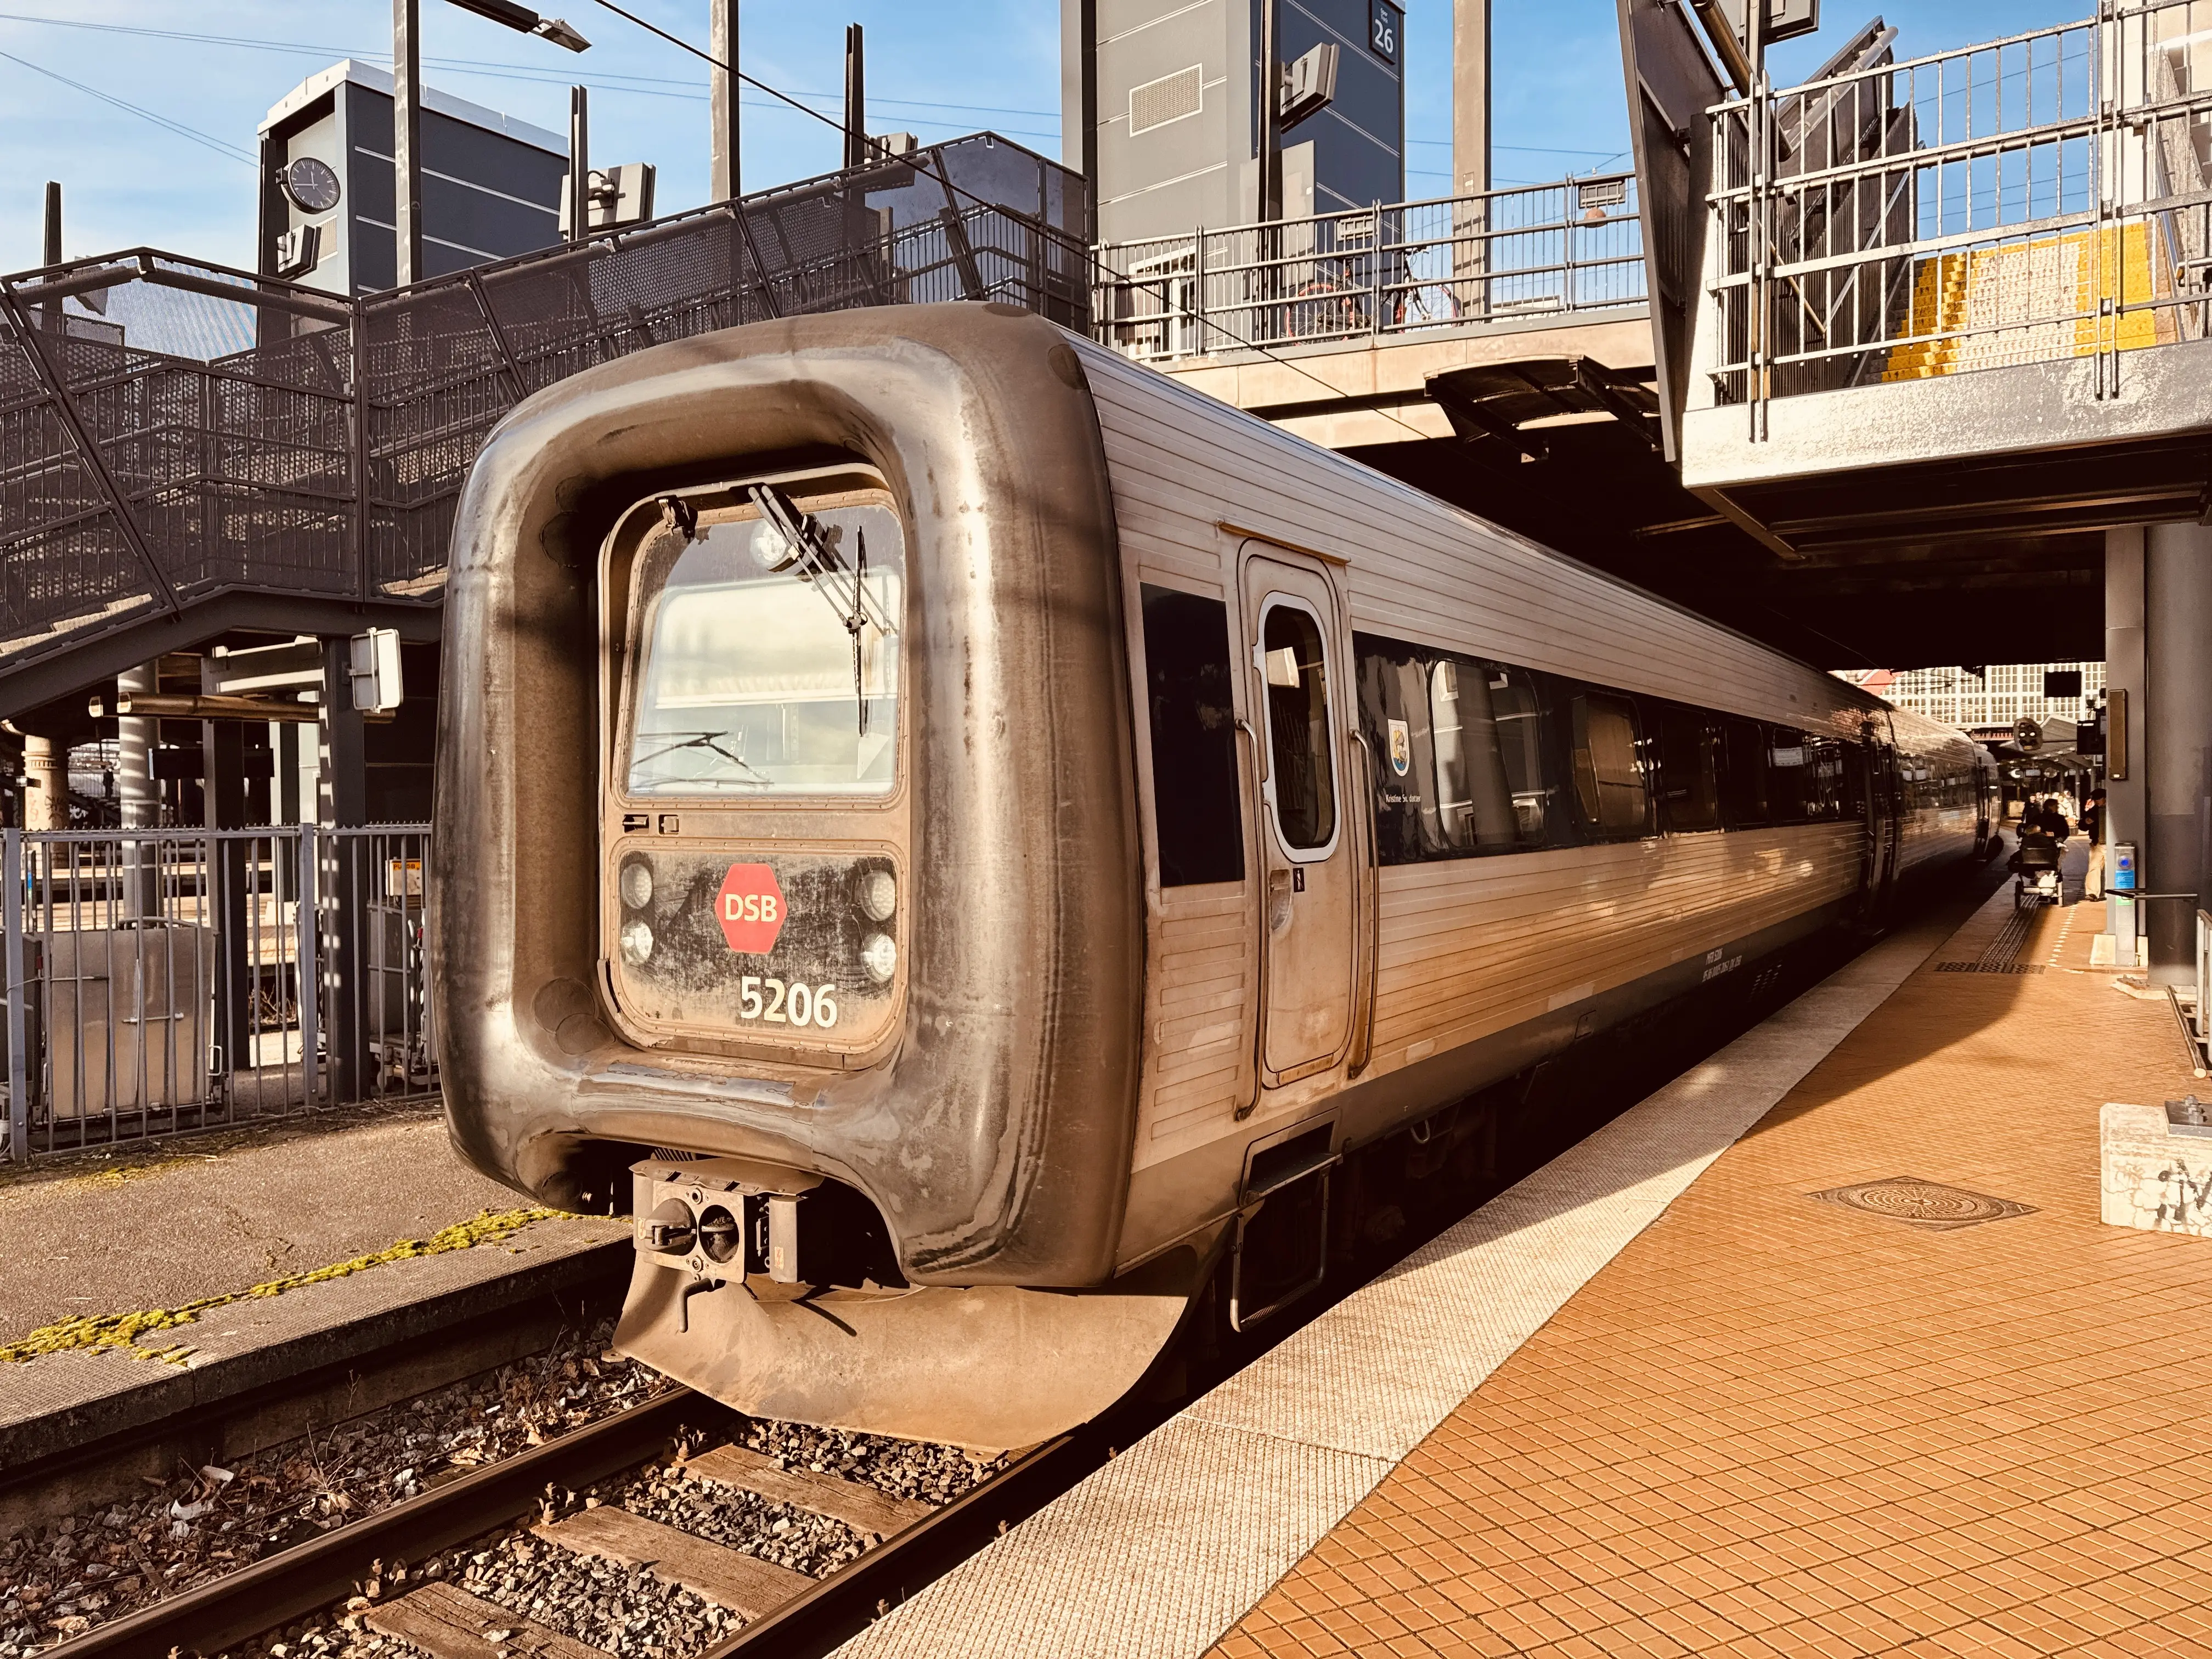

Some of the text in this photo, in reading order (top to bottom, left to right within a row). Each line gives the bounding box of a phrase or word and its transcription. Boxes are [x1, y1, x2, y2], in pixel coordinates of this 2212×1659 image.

[1375, 19, 1393, 53] 26
[725, 894, 777, 922] DSB
[741, 976, 837, 1028] 5206
